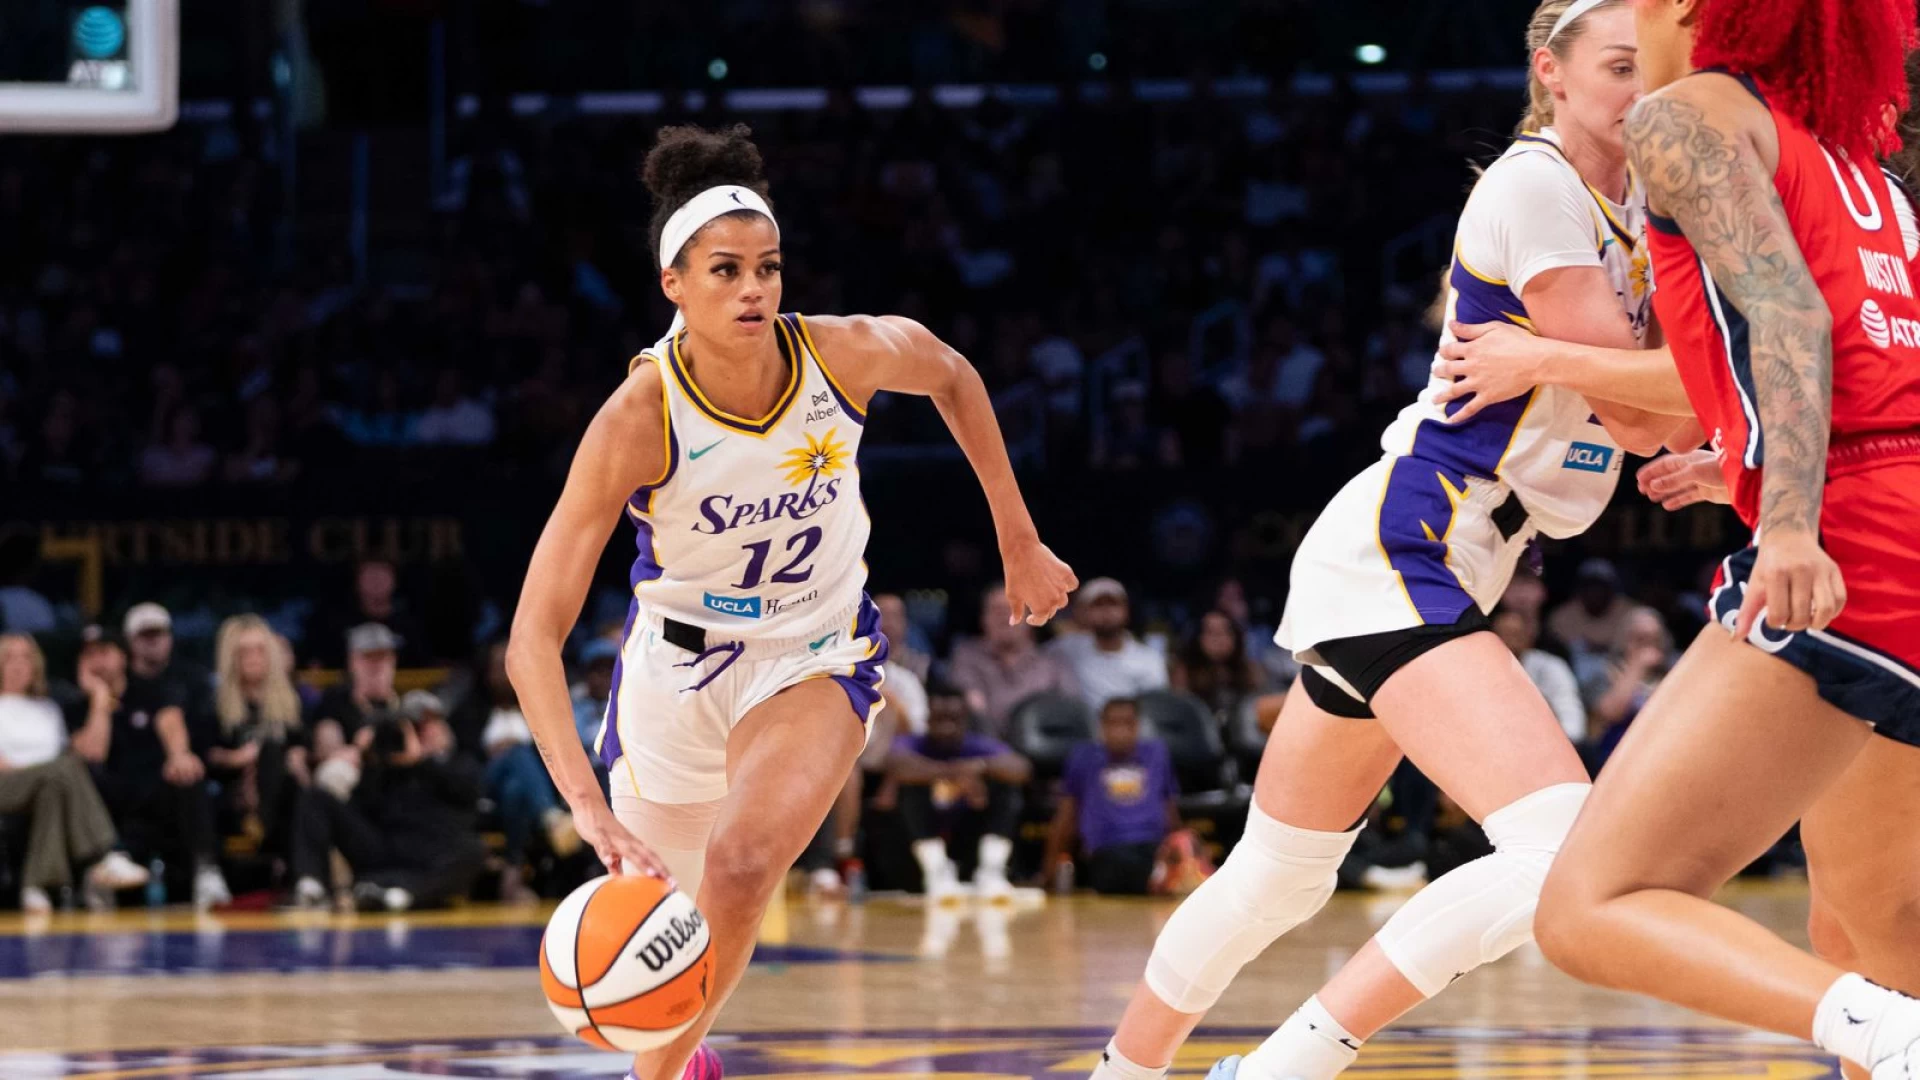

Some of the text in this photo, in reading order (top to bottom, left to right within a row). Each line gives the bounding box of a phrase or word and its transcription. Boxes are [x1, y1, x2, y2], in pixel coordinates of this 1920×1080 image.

[1567, 448, 1604, 466] UCLA
[731, 526, 822, 590] 12
[710, 599, 754, 613] UCLA
[635, 908, 703, 972] Wilso
